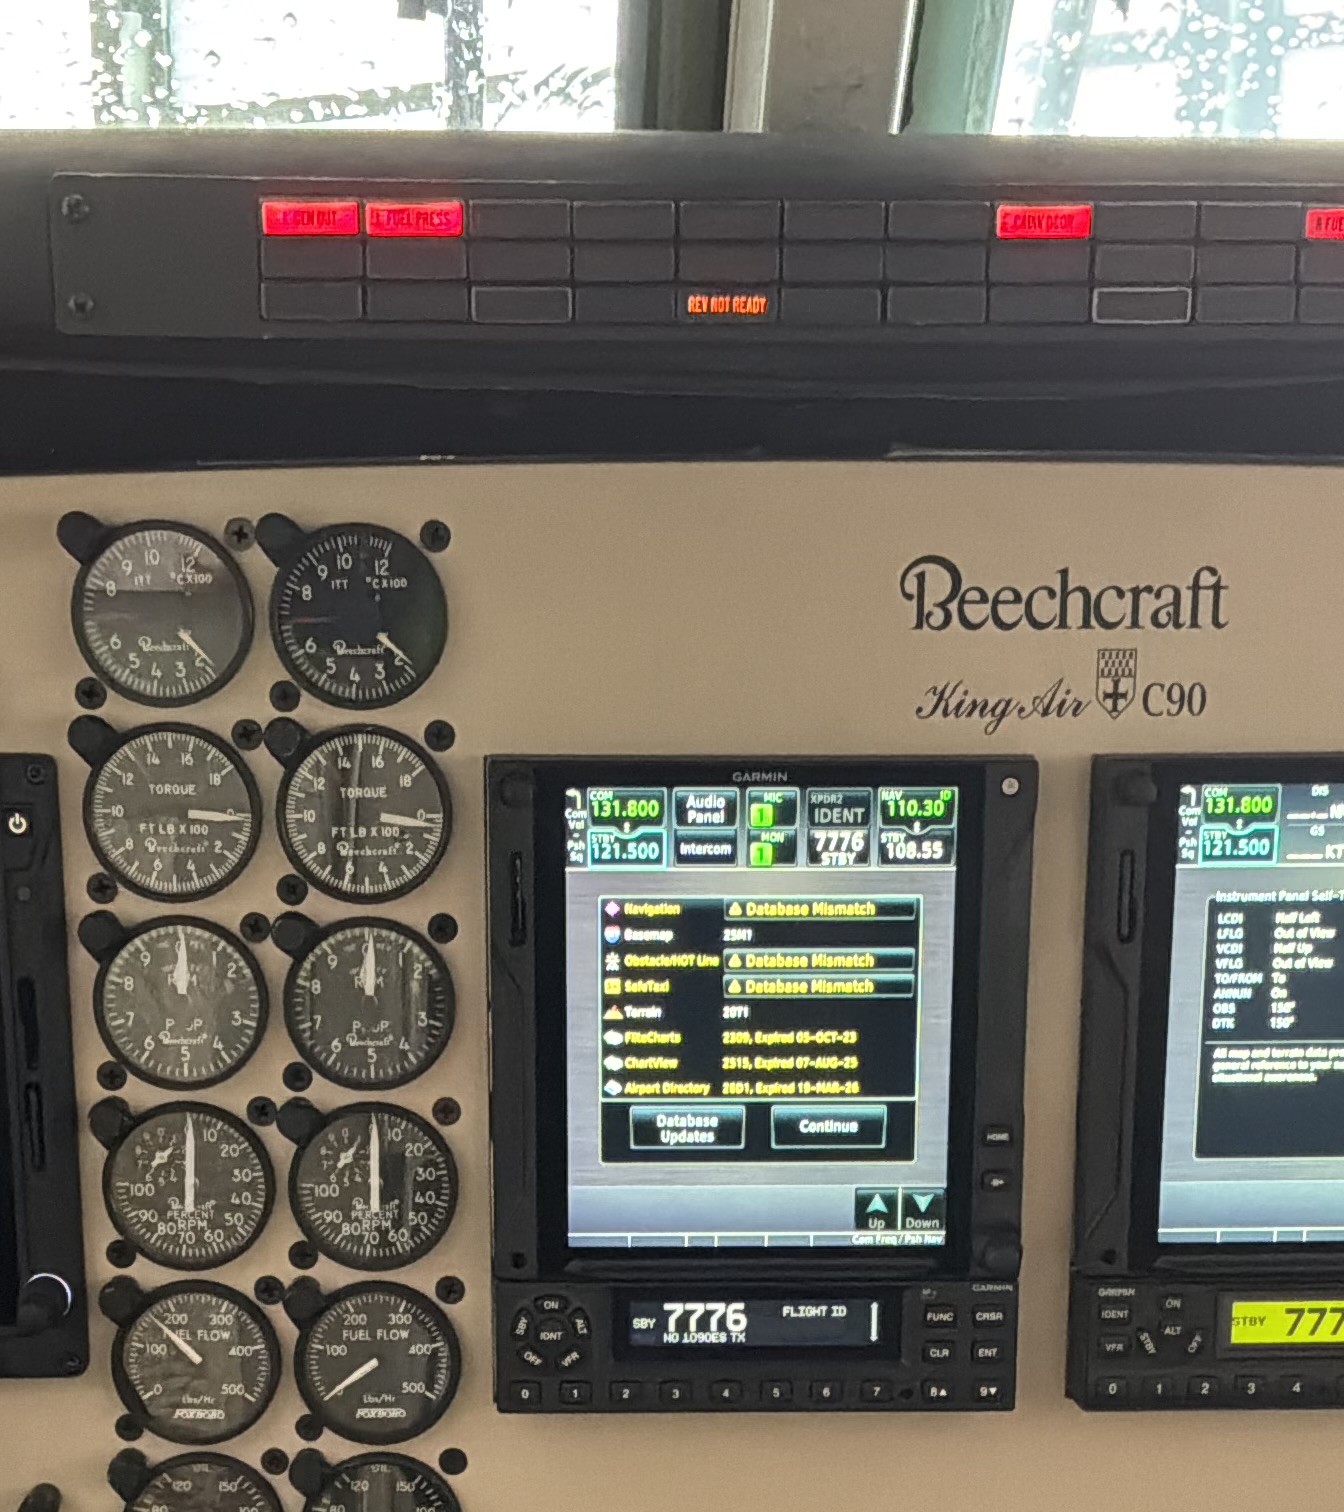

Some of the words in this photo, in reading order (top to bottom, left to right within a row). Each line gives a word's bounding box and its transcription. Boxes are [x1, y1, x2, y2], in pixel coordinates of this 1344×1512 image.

[688, 295, 708, 314] REV
[711, 295, 730, 314] NOT
[733, 295, 768, 314] READY
[900, 554, 1229, 631] Beechcraft
[916, 679, 1020, 735] King
[1017, 677, 1092, 720] Air
[1142, 682, 1206, 717] C90
[732, 771, 788, 782] GARMIN
[149, 784, 197, 796] TORQUE
[340, 786, 387, 798] TORQUE
[591, 800, 660, 817] 131.800
[686, 795, 726, 809] Audio
[887, 800, 944, 817] 110.30
[1206, 797, 1273, 814] 131.800
[687, 811, 725, 824] Panel
[814, 808, 864, 824] IDENT
[140, 823, 154, 835] FT
[159, 823, 176, 835] LB
[179, 823, 187, 835] X
[189, 823, 208, 835] 100
[680, 843, 731, 855] Intercom
[814, 833, 864, 852] 7776
[1203, 839, 1270, 856] 121.500
[591, 843, 660, 859] 121.500
[886, 842, 943, 859] 108.55
[821, 853, 856, 866] STBY
[1216, 890, 1276, 903] Instrument
[1279, 890, 1309, 902] Panel
[746, 902, 808, 916] Database
[812, 902, 875, 916] Mismatch
[746, 954, 808, 968] Database
[812, 954, 874, 968] Mismatch
[746, 979, 808, 994] Database
[812, 979, 874, 993] Mismatch
[656, 1115, 718, 1129] Database
[799, 1120, 858, 1134] Continue
[661, 1130, 714, 1144] Updates
[177, 1219, 208, 1231] RPM
[362, 1219, 391, 1231] RPM
[905, 1217, 939, 1229] Down
[663, 1304, 747, 1331] 7776
[782, 1306, 828, 1317] FLIGHT
[832, 1306, 847, 1316] ID
[1101, 1309, 1129, 1321] IDENT
[198, 1330, 230, 1342] FLOW
[342, 1329, 371, 1341] FUEL
[376, 1329, 410, 1341] FLOW
[229, 1344, 252, 1357] 400
[929, 1348, 950, 1359] CLR
[977, 1347, 997, 1358] ENT
[401, 1382, 425, 1394] 500
